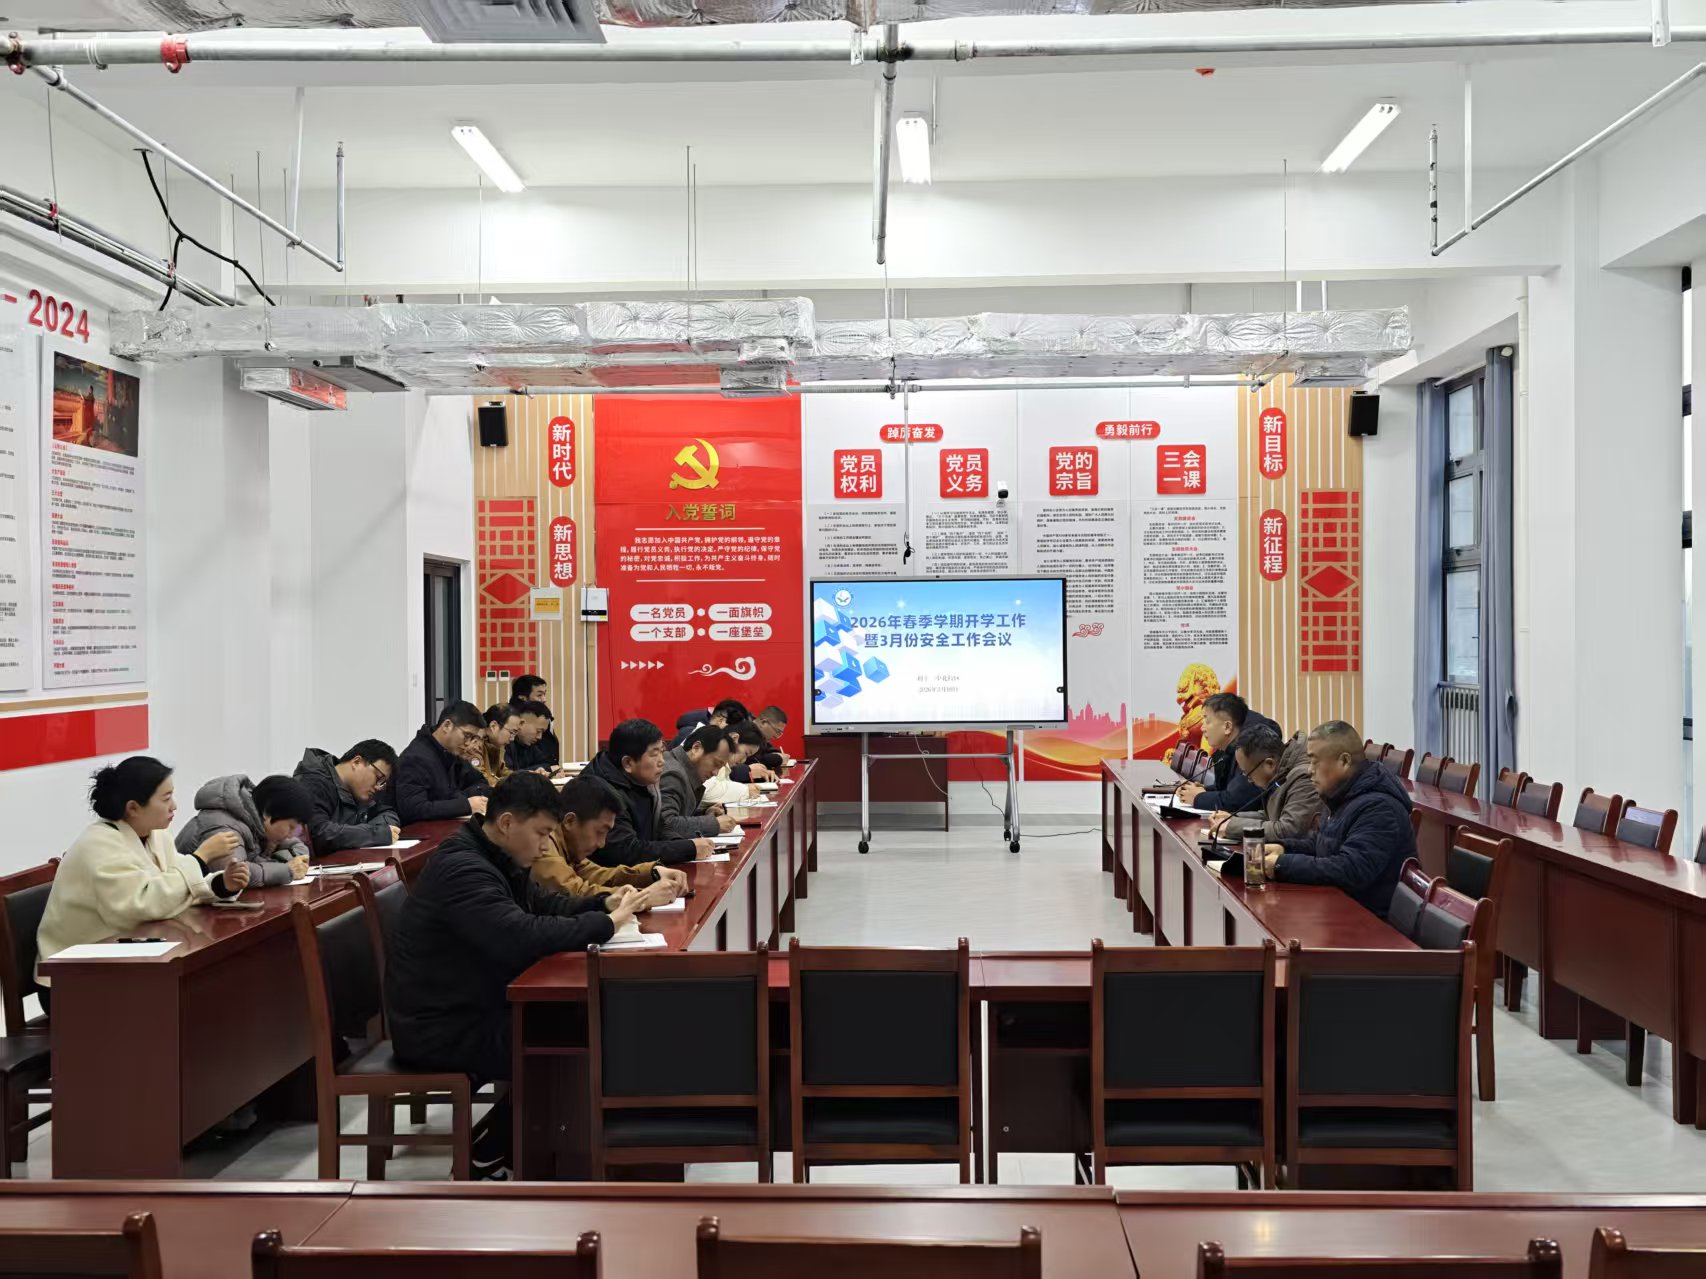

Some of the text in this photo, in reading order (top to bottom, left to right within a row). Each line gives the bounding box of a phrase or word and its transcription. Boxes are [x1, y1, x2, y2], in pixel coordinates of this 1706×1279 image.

[28, 289, 89, 344] 2024
[1104, 423, 1153, 437] 勇毅前行
[552, 423, 572, 480] 新时代
[1263, 415, 1283, 472] 新目标
[840, 454, 877, 473] 党员
[946, 453, 983, 473] 党员
[1055, 451, 1093, 470] 党的
[1163, 450, 1201, 468] 三会
[840, 475, 877, 493] 权利
[946, 474, 983, 492] 义务
[1055, 472, 1093, 490] 宗旨
[1163, 470, 1201, 489] 一课
[665, 503, 736, 521] 入党誓词
[553, 523, 573, 580] 新思想
[1263, 516, 1283, 574] 新征程
[637, 607, 687, 619] 一名党员
[716, 607, 765, 619] 一面旗帜
[850, 613, 1026, 629] 2026年春季学期开学工作
[637, 626, 687, 638] 一个支部
[716, 626, 765, 638] 一座堡垒
[864, 632, 1012, 648] 暨3月份安全工作会议
